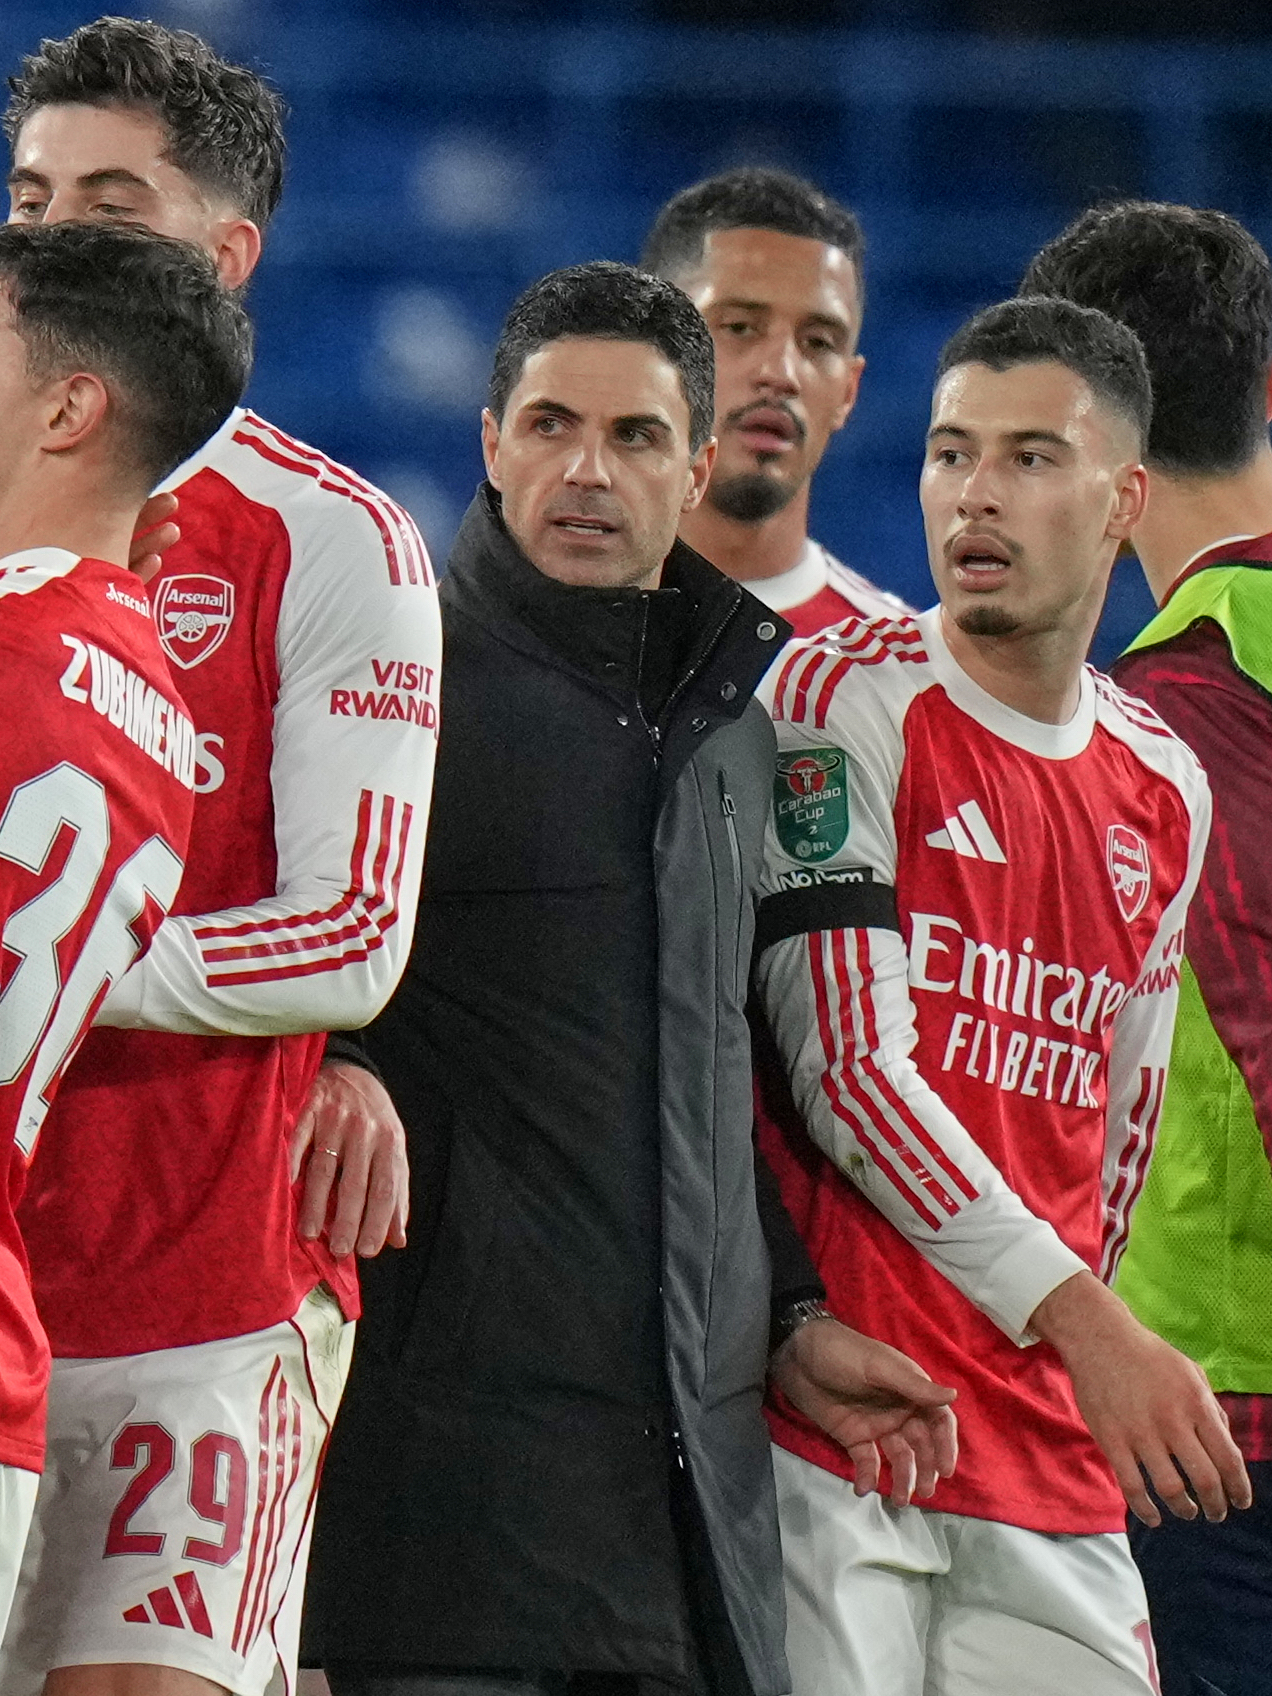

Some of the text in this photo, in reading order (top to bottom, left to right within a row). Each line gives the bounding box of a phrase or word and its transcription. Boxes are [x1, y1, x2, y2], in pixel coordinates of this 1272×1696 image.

[105, 583, 151, 619] Arsenal
[166, 588, 224, 607] Arsenal
[371, 659, 434, 695] VISIT
[330, 689, 438, 740] RWAND
[778, 786, 841, 815] Carabao
[794, 806, 825, 823] Cup
[808, 825, 818, 835] 2
[779, 869, 864, 891] No rm
[907, 911, 1132, 1035] Emirate
[102, 1420, 249, 1569] 29
